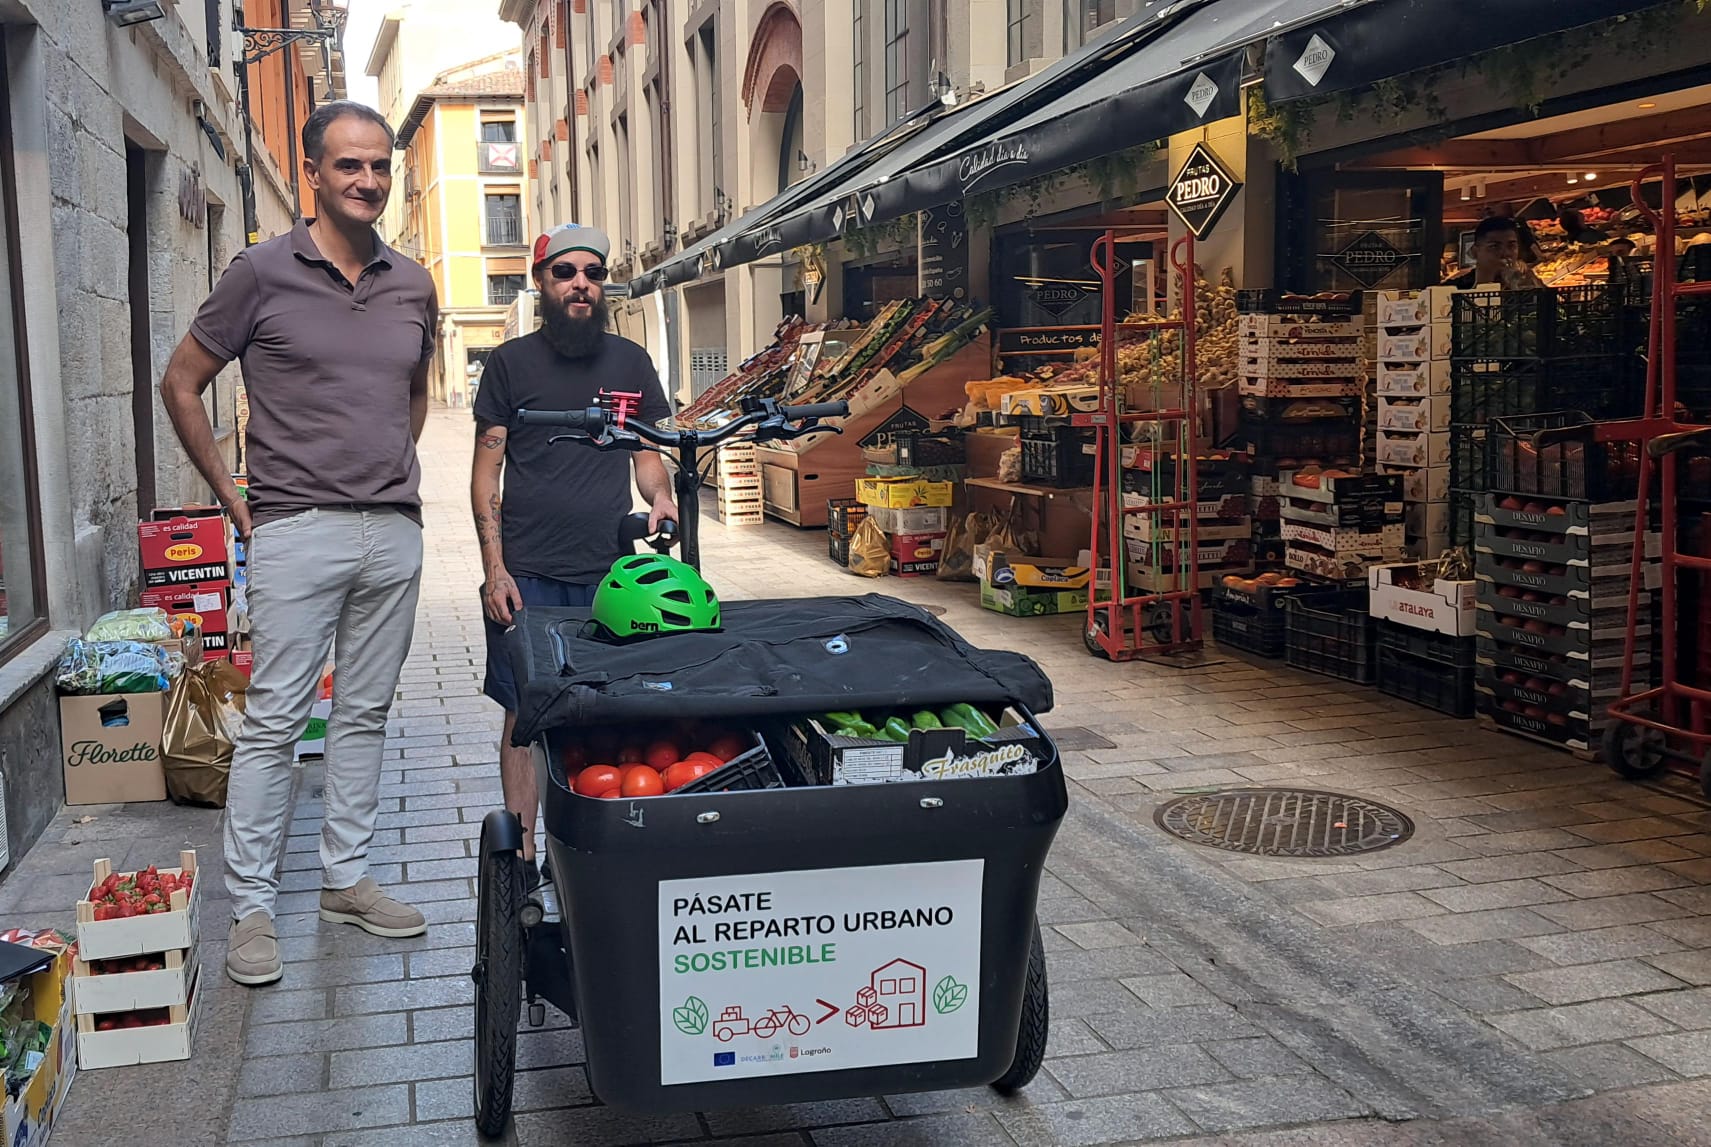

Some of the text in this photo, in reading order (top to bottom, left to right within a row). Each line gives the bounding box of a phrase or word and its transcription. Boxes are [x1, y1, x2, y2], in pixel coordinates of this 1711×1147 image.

[1303, 50, 1327, 66] PEDRO
[1192, 87, 1213, 100] PEDRO
[960, 146, 994, 181] Calidad
[1177, 175, 1219, 200] PEDRO
[1345, 251, 1396, 263] PEDRO
[1037, 290, 1077, 299] PEDRO
[1020, 335, 1083, 344] Productos
[172, 523, 198, 531] calidad
[170, 547, 196, 557] Peris
[915, 562, 938, 570] VICENT
[169, 566, 225, 582] VICENTIN
[631, 620, 659, 631] bern
[68, 741, 158, 767] Florette
[924, 744, 1023, 780] Frasquito
[674, 892, 772, 916] PÁSATE
[673, 907, 953, 945] AL REPARTO URBANO
[674, 943, 836, 974] SOSTENIBLE
[800, 1047, 831, 1056] Logroño
